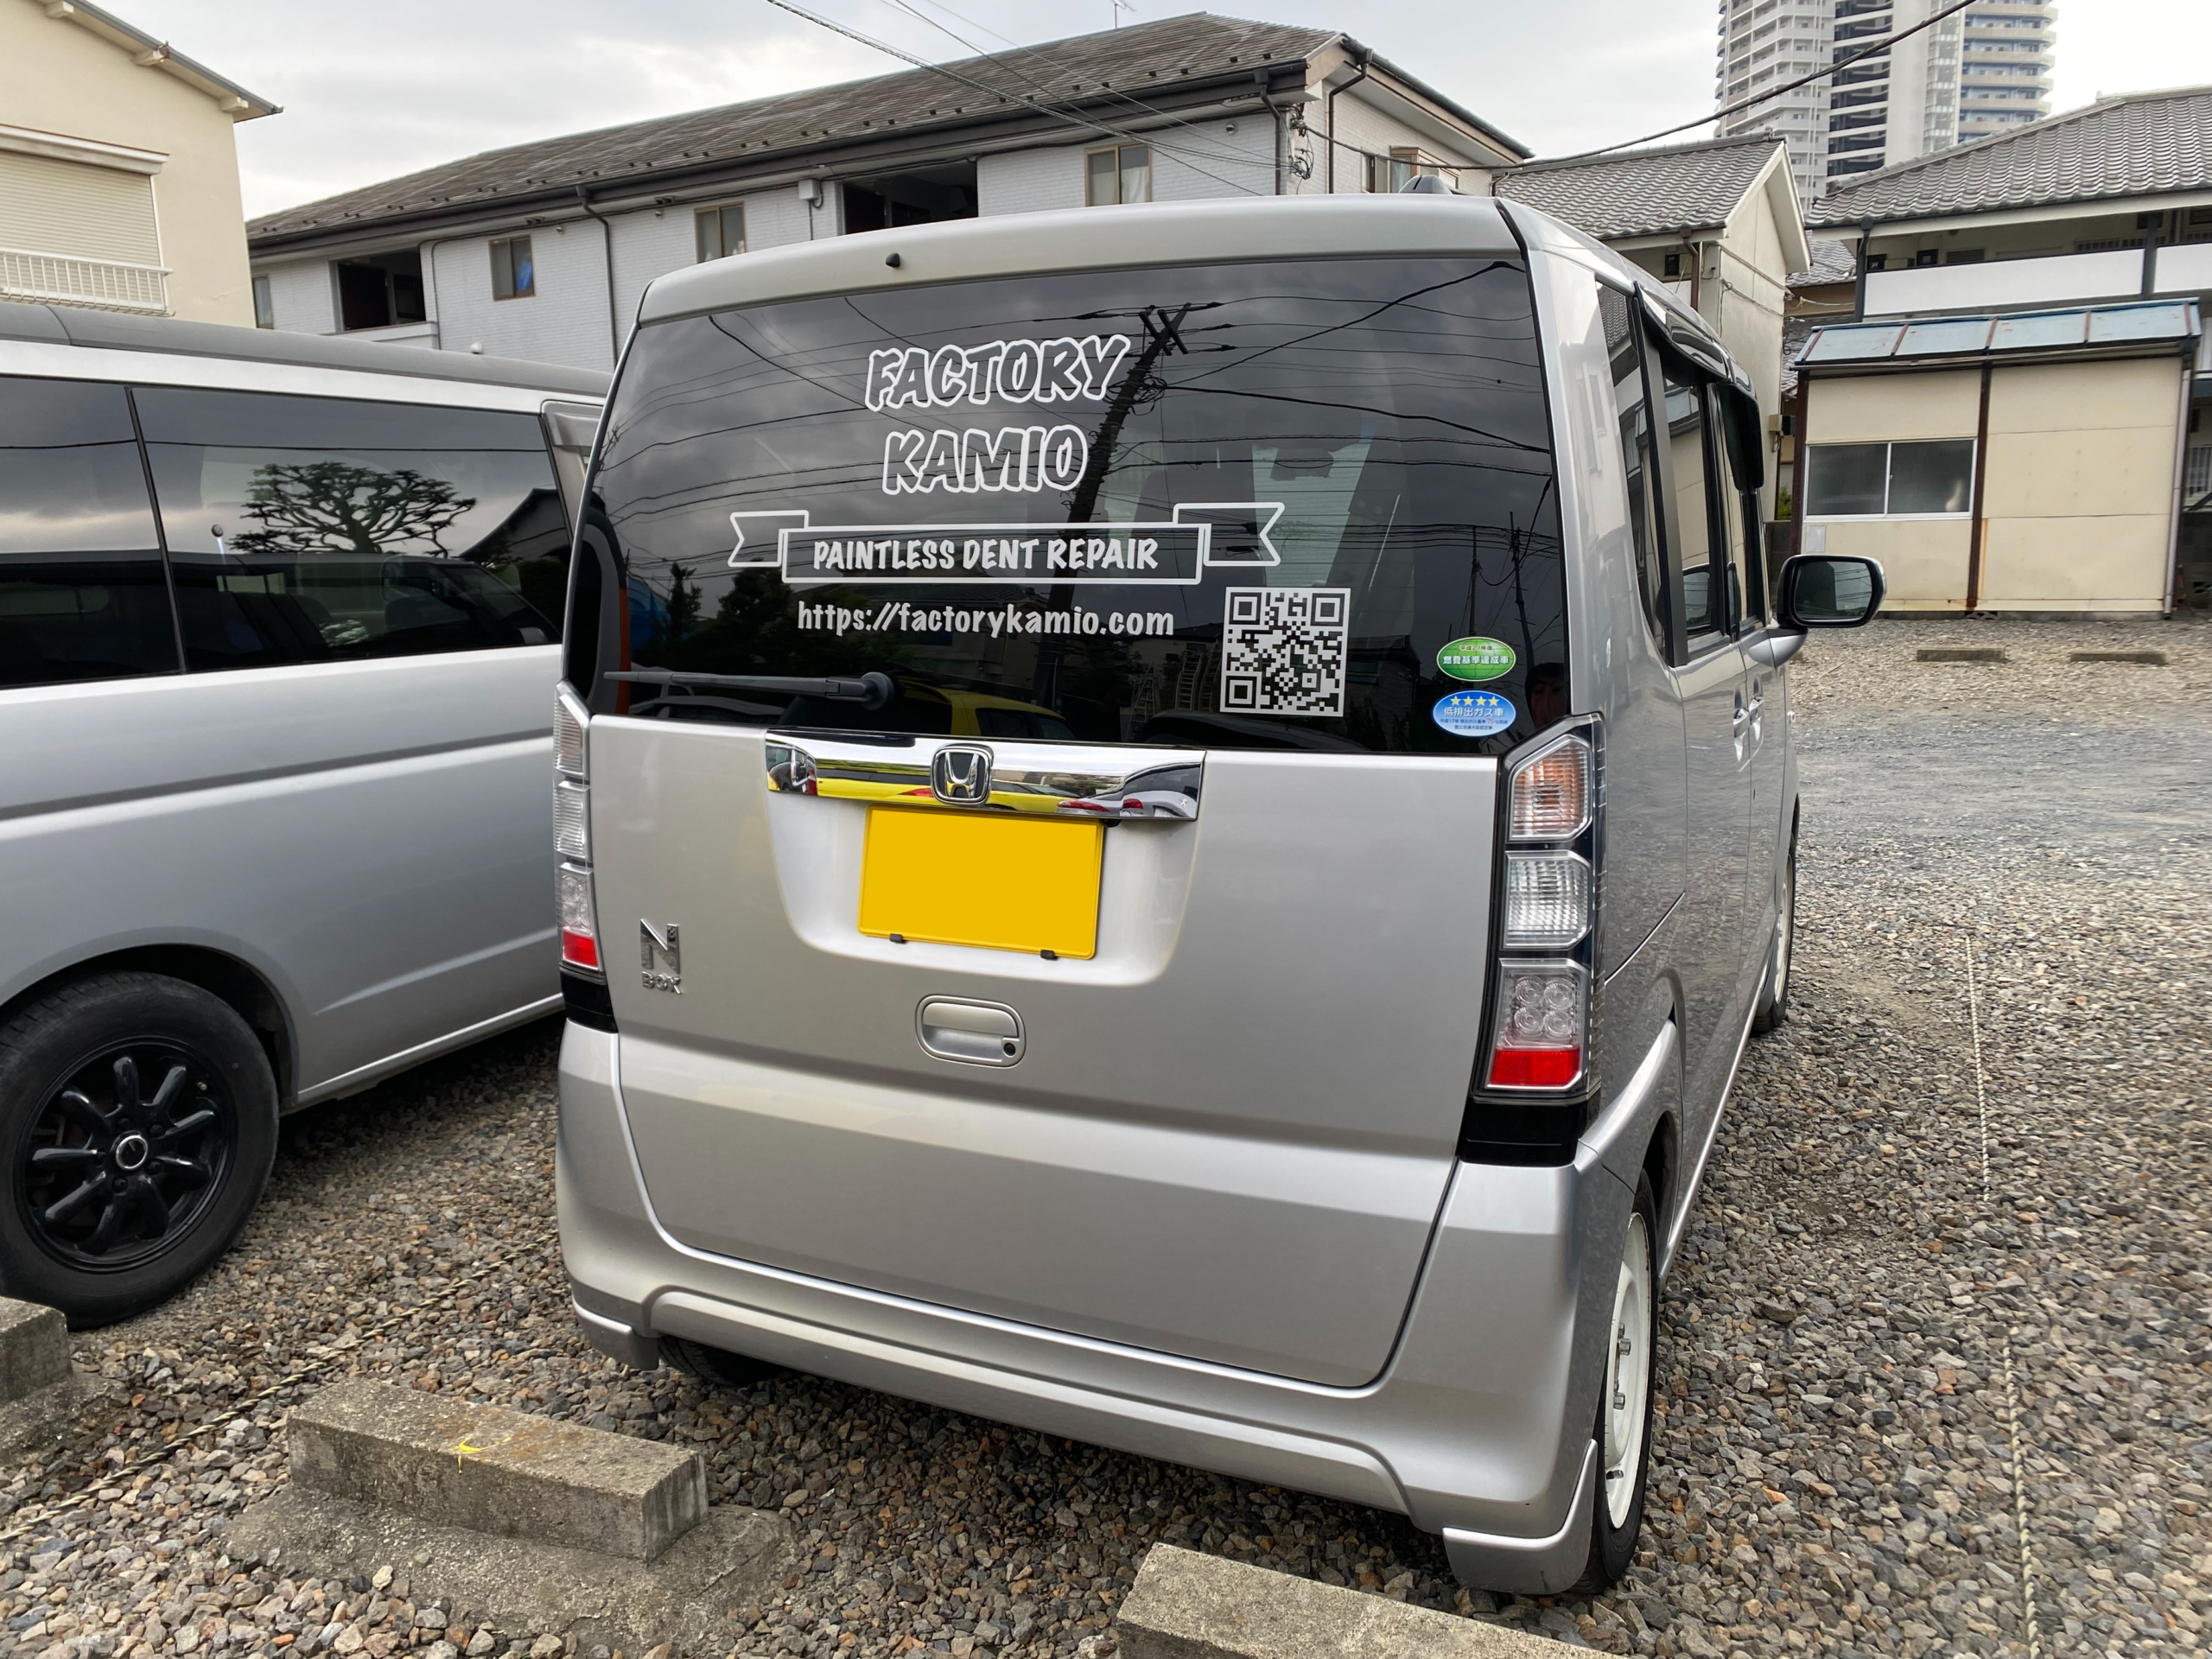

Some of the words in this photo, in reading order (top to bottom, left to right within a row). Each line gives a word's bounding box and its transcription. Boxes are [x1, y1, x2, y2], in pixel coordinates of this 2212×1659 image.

[864, 334, 1132, 413] FACTORY
[881, 423, 1090, 496] KAMIO
[813, 539, 955, 570] PAINTLESS
[963, 538, 1039, 569] DENT
[1046, 537, 1159, 569] REPAIR
[798, 601, 1174, 639] https://factorykamio.com
[1443, 655, 1510, 664] 燃費基準達成車
[1444, 707, 1505, 718] 低排出ガス車
[641, 970, 682, 995] BOX
